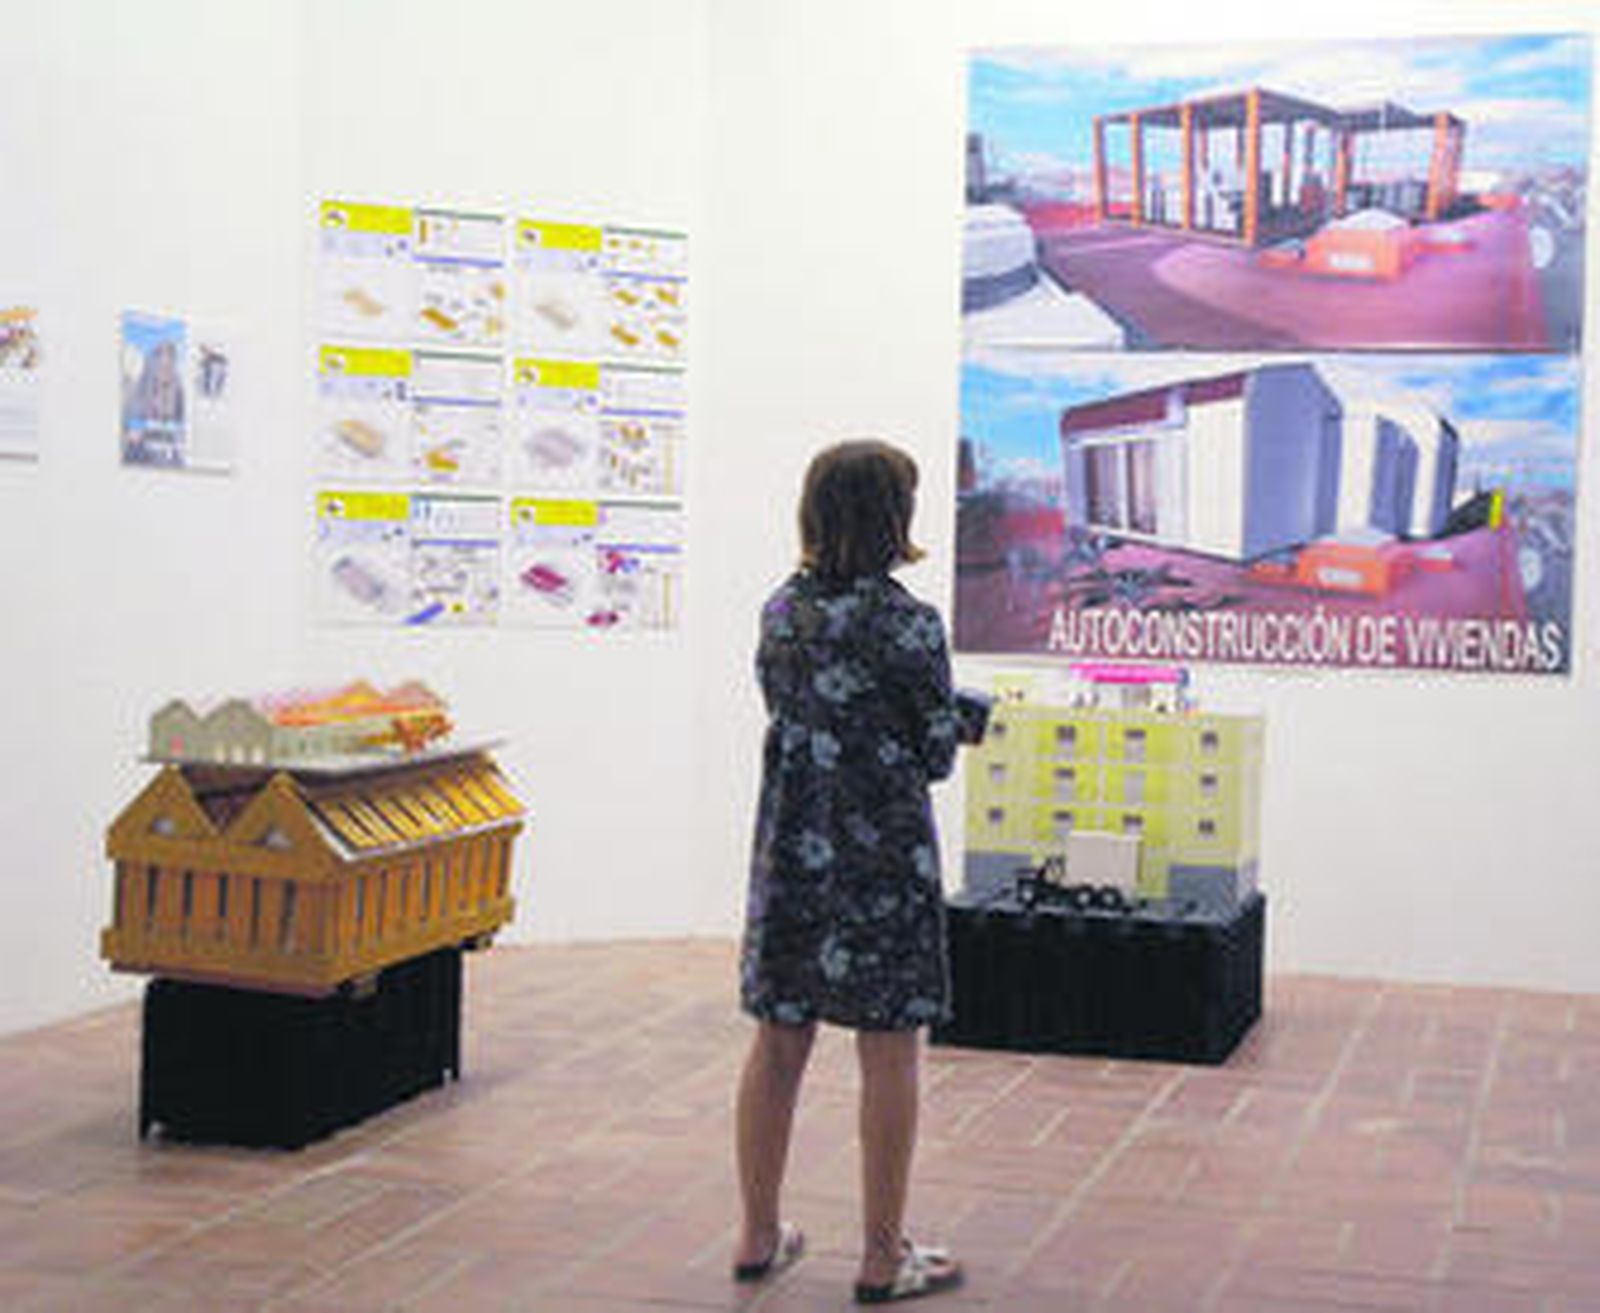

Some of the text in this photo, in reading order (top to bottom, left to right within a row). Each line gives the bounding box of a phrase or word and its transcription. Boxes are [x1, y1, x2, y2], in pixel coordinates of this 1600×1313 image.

[1049, 605, 1562, 670] AUTOCONSTRUCCIÓN DE VIVIENDAS
